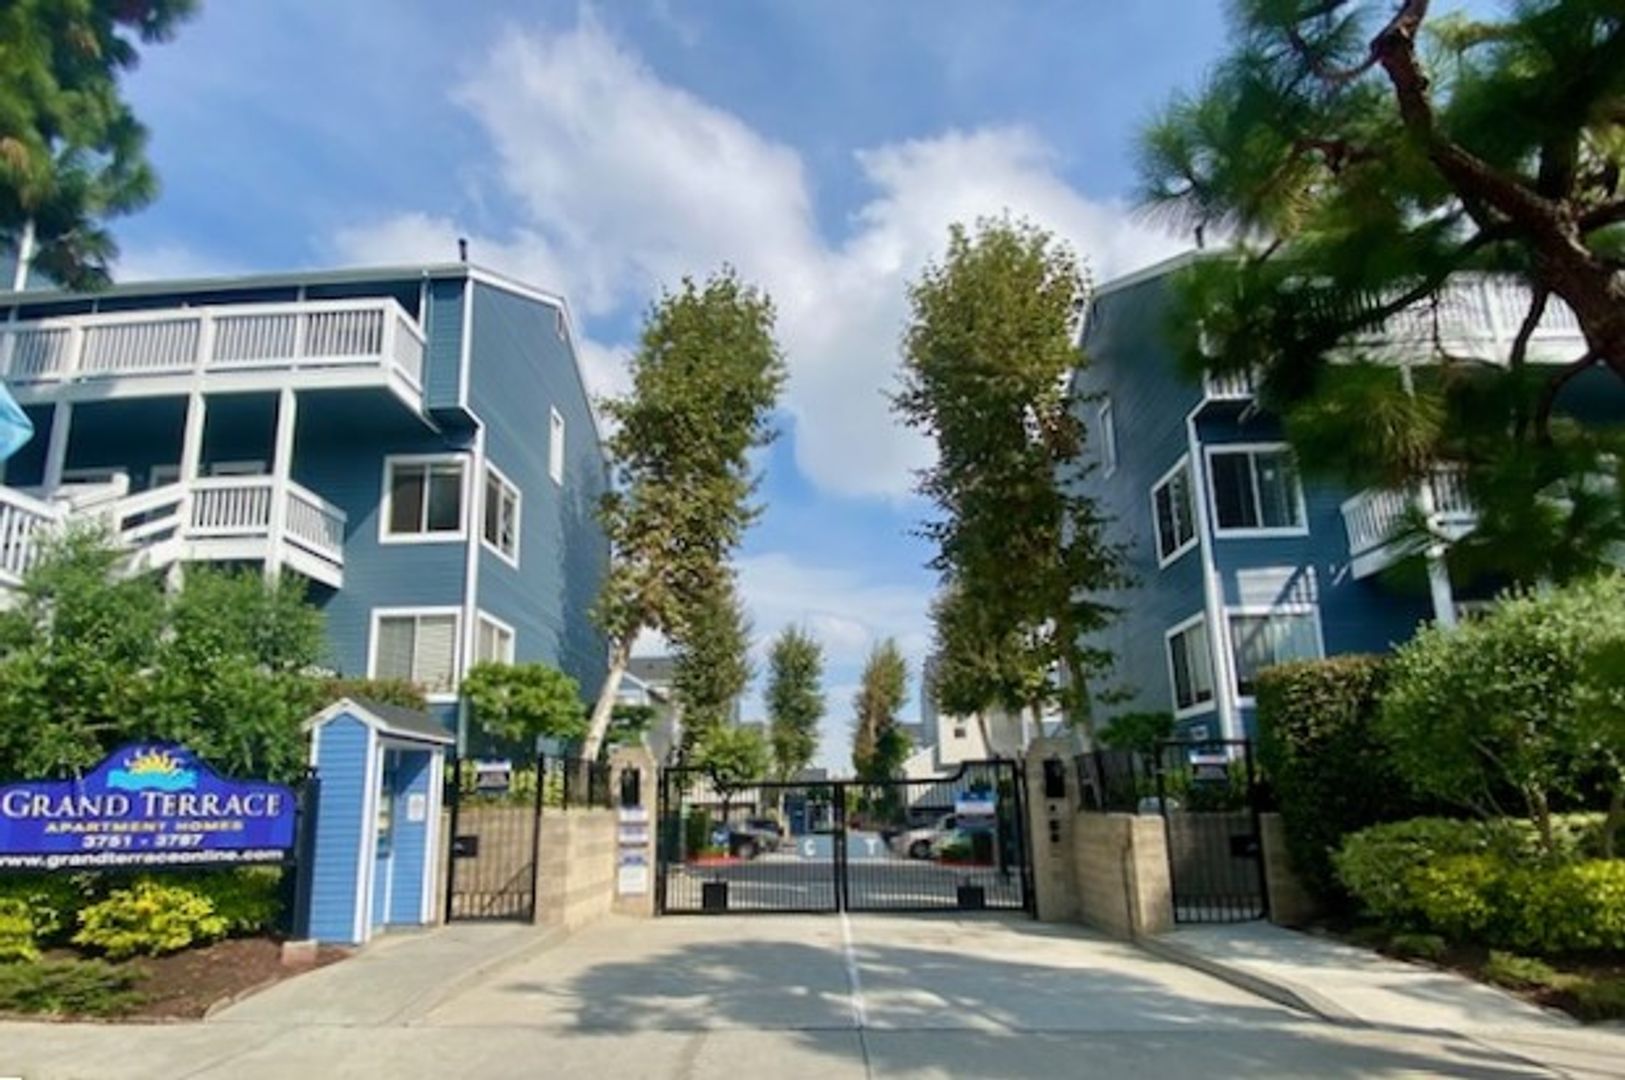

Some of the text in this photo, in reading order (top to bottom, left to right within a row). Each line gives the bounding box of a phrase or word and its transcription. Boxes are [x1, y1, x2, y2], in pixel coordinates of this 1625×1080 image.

[2, 789, 281, 819] GRAND TERRACE
[44, 820, 244, 833] APARTMENT HOMES
